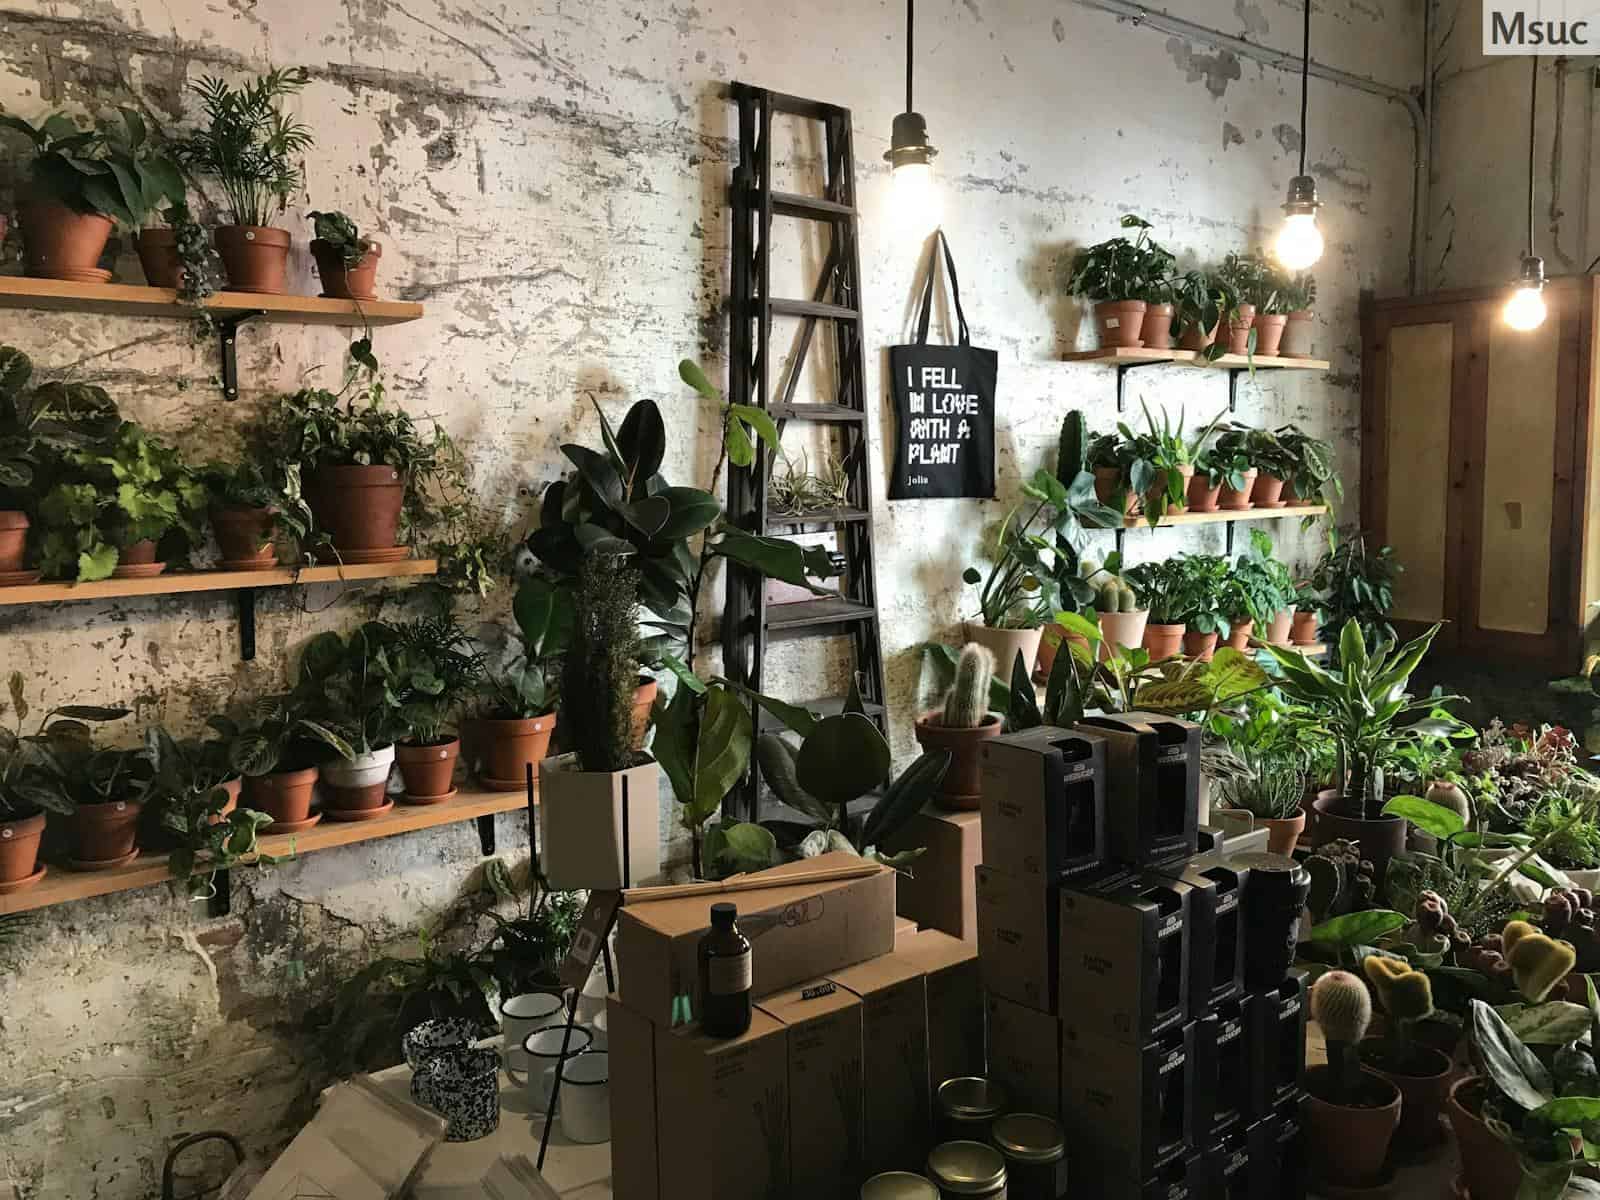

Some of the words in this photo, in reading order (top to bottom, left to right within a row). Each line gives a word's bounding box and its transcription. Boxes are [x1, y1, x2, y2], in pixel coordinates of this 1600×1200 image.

[907, 365, 913, 388] I
[921, 367, 962, 389] FELL
[909, 391, 925, 414] IN
[932, 393, 978, 415] LOVE
[909, 418, 950, 439] WITH
[957, 419, 971, 439] A
[908, 443, 960, 465] PLANT
